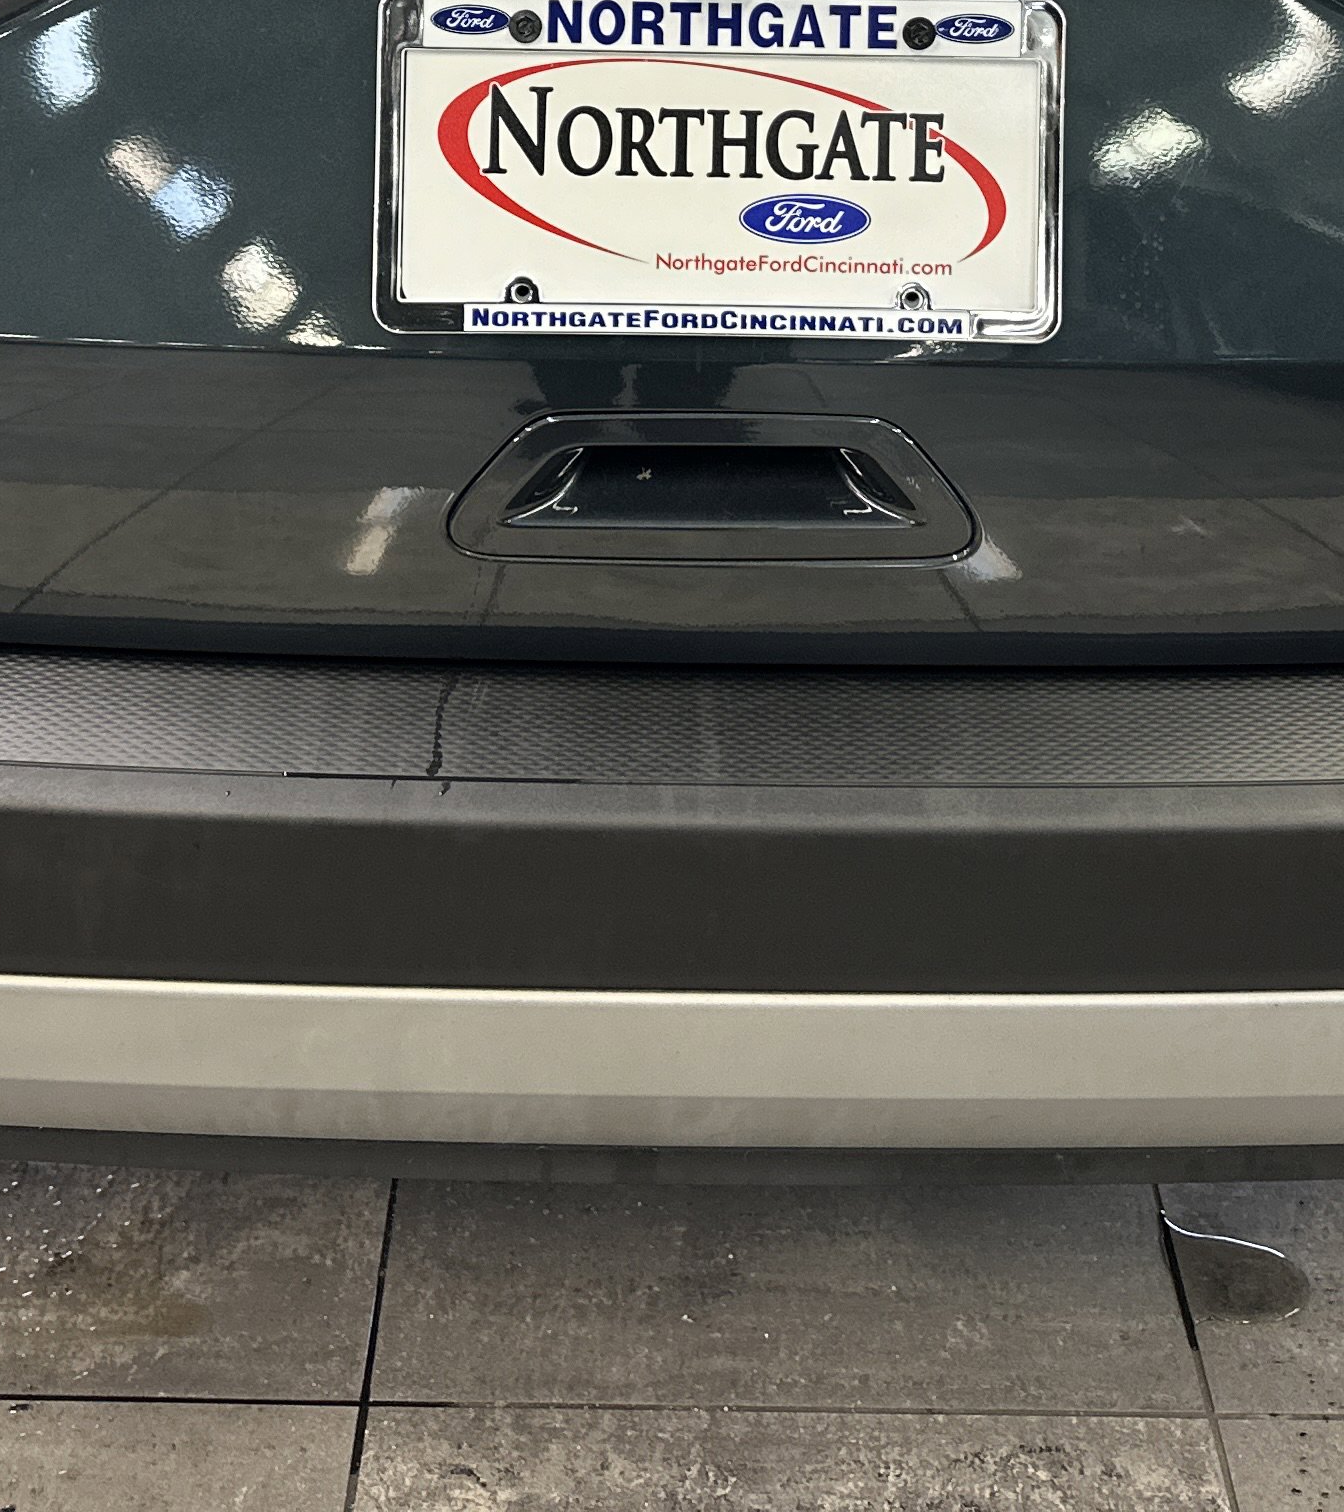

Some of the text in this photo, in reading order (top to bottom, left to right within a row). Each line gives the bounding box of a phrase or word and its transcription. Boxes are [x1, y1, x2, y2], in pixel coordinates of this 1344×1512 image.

[446, 8, 495, 29] Ford
[949, 17, 999, 38] Ford
[481, 83, 947, 184] NORTHGATE
[764, 201, 845, 234] Ford
[655, 253, 953, 276] NorthgateFordCincinnati.com
